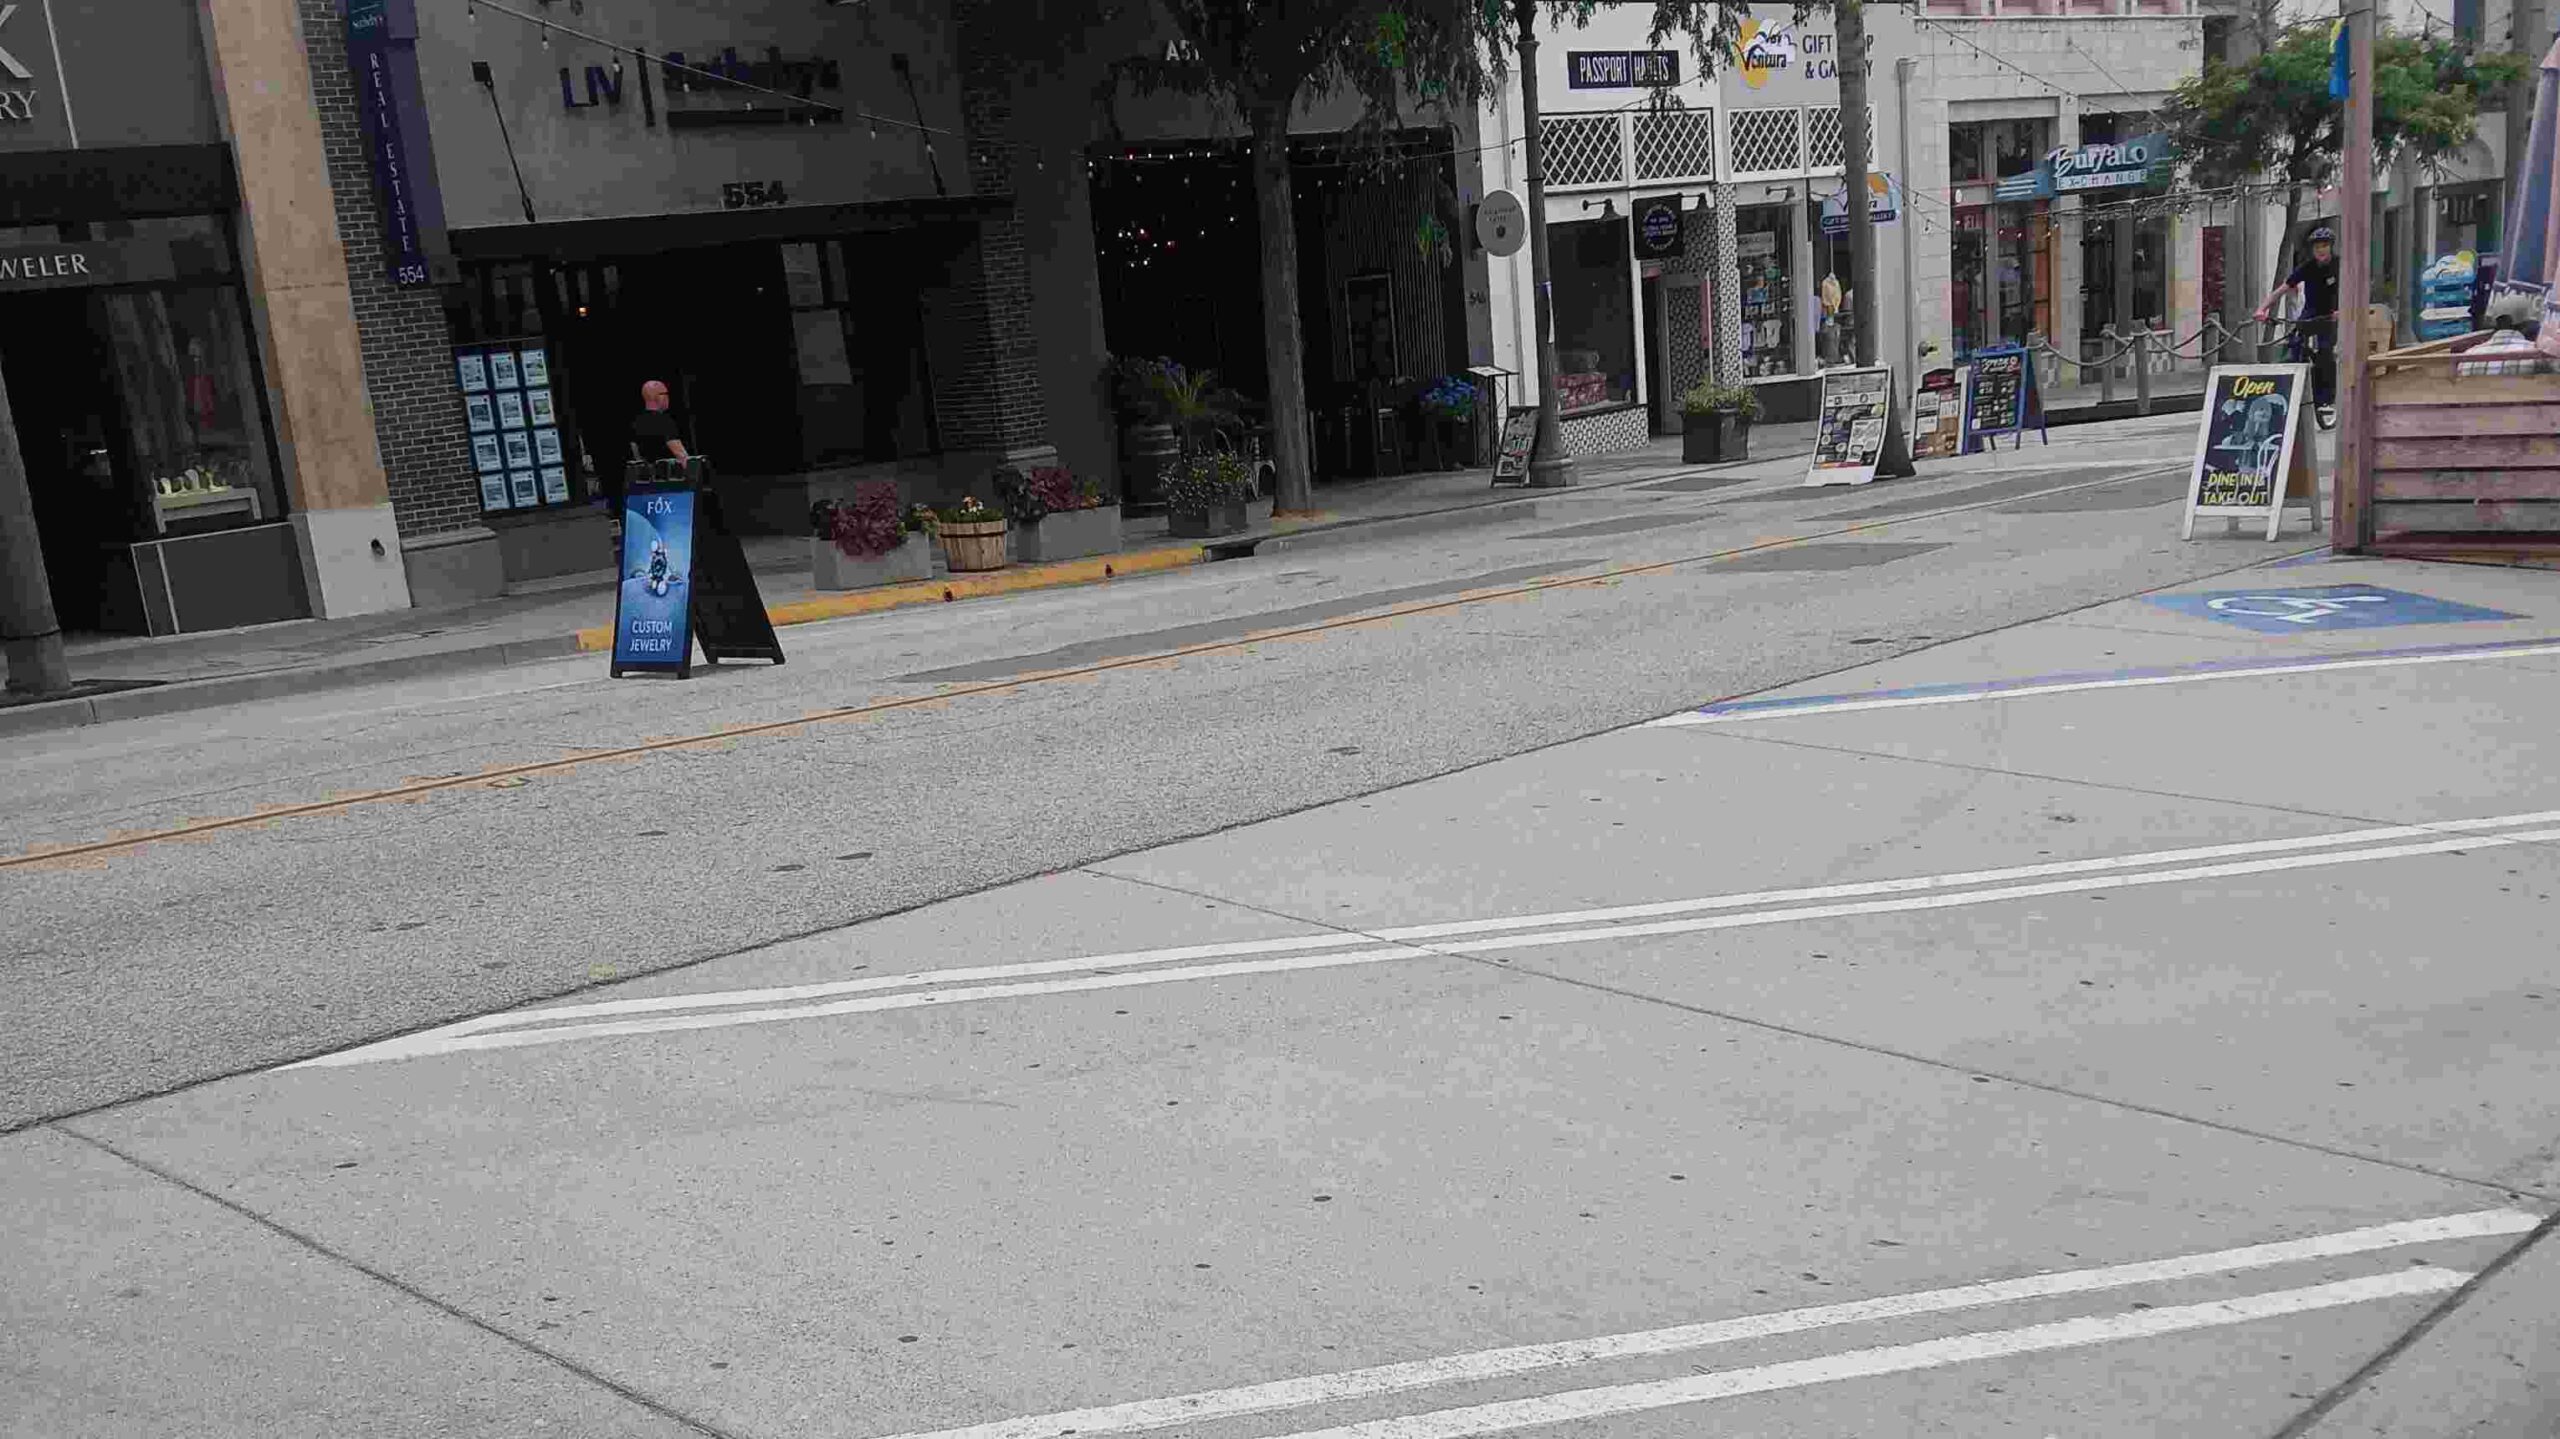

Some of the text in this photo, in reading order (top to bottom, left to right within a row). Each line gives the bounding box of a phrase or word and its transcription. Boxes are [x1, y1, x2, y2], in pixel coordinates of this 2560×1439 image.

[1803, 34, 1834, 54] GIFT
[1579, 56, 1627, 83] PASSPORT
[1805, 60, 1815, 79] &
[369, 52, 391, 129] REAL
[386, 142, 412, 252] ESTATE
[2058, 170, 2148, 188] EXCHANGE
[399, 265, 425, 284] 554
[2233, 375, 2276, 398] Open
[2208, 472, 2236, 486] DINE
[2240, 473, 2253, 486] IN
[647, 498, 673, 514] FOX
[2203, 491, 2268, 505] TAKE OUT
[631, 620, 673, 634] CUSTOM
[630, 637, 673, 652] JEWELRY
